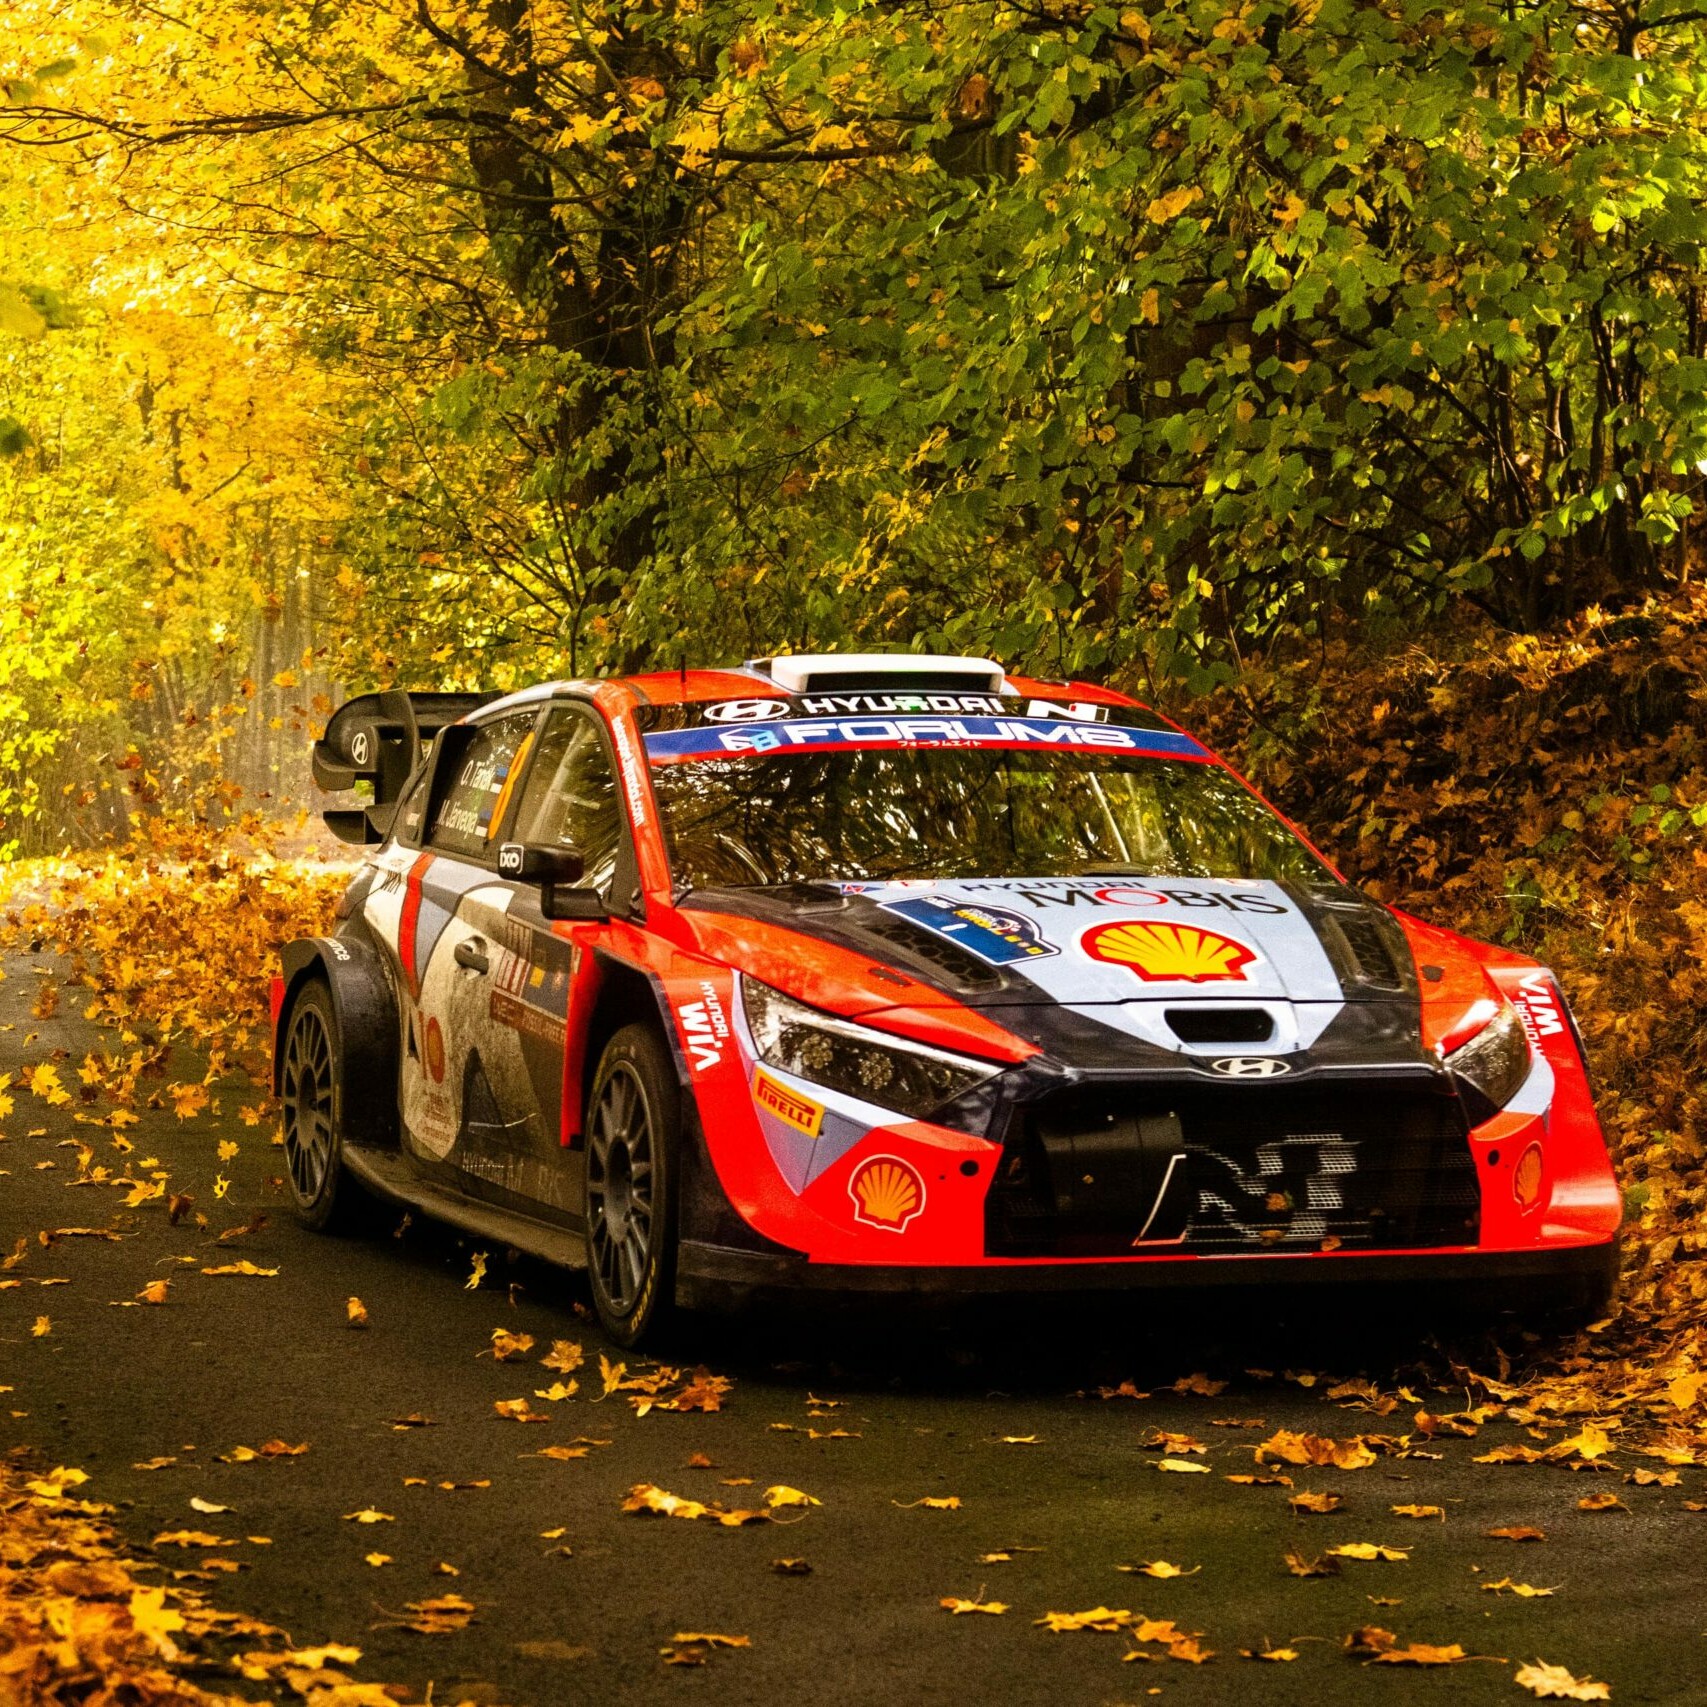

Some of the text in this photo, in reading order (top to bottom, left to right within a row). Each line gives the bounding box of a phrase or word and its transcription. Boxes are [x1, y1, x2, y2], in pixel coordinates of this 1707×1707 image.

[800, 694, 1005, 714] HYUNDAI
[783, 718, 1136, 748] FORUM8
[897, 740, 983, 748] フォーラムエイト
[959, 881, 1147, 892] HYUNDAI
[1016, 888, 1289, 915] MOBIS
[699, 981, 730, 1038] HYUNDAI
[757, 1076, 816, 1129] PIRELLI
